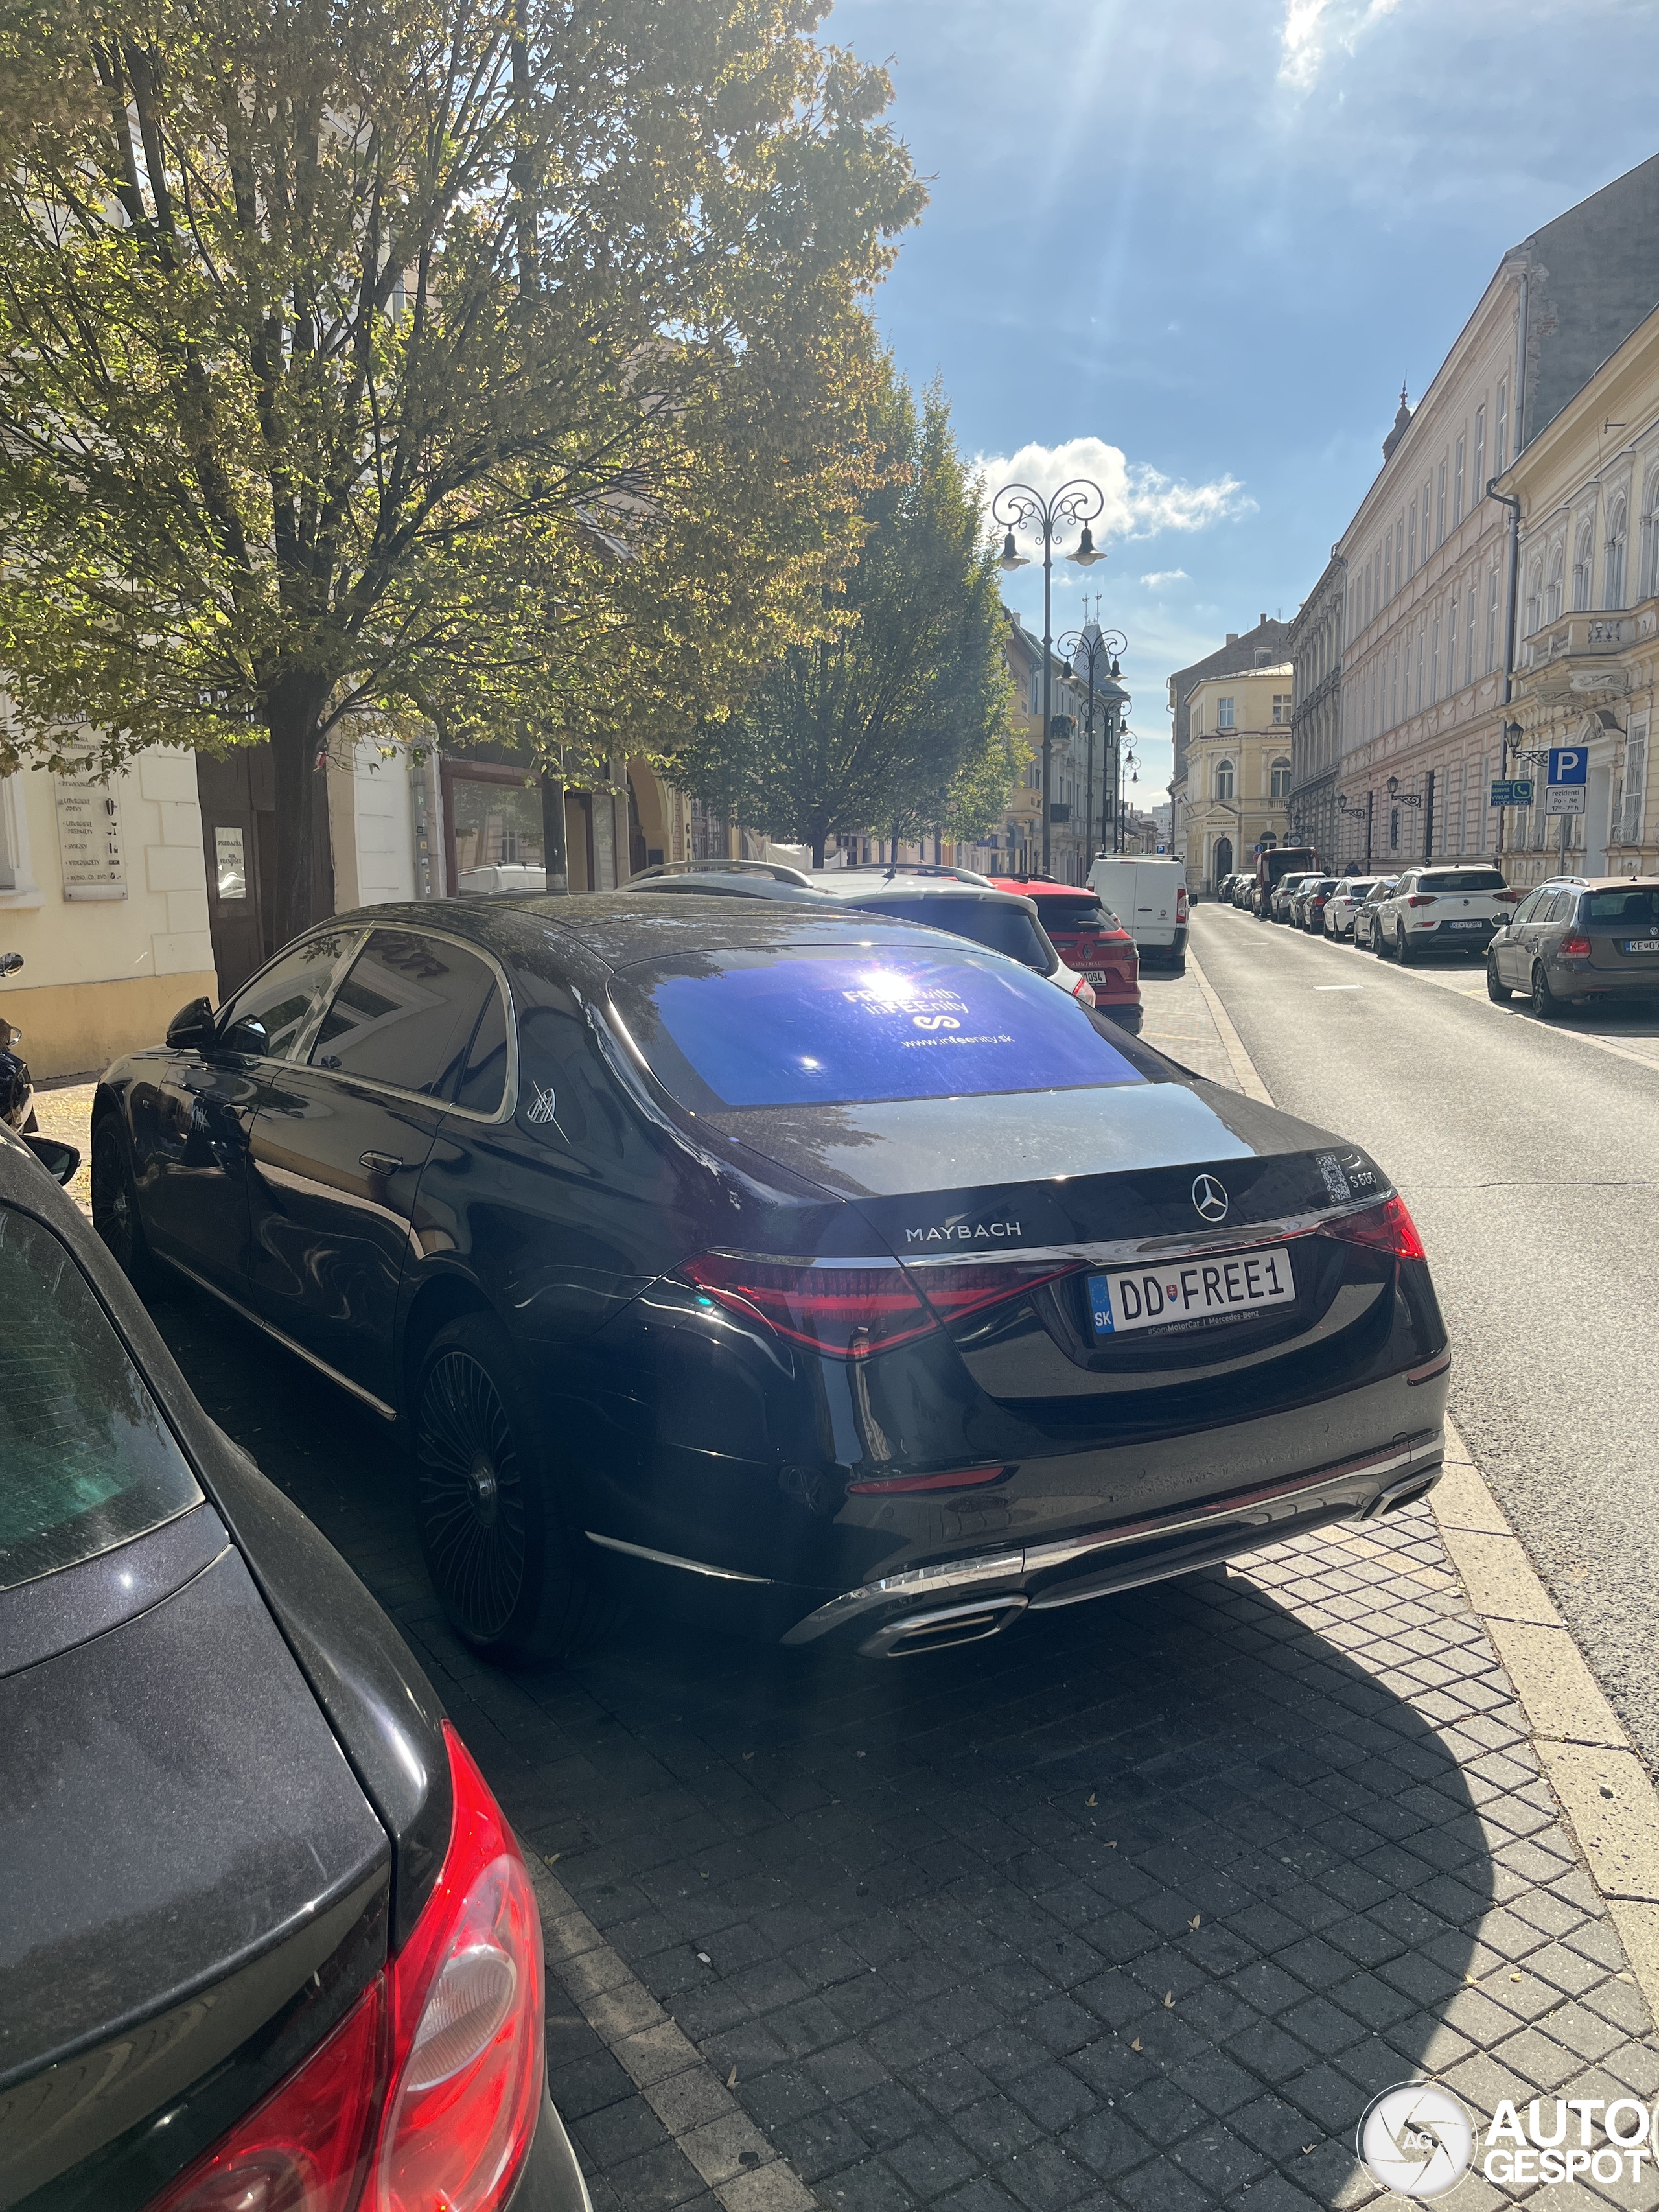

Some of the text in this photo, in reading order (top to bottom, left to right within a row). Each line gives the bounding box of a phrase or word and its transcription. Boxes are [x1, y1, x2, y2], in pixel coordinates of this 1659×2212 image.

[1557, 752, 1579, 780] P
[901, 1034, 1015, 1047] www.infeenity.sk
[905, 1222, 1022, 1242] MAYBACH
[1095, 1310, 1112, 1327] SK
[1208, 1310, 1260, 1325] Mercedes-Benz
